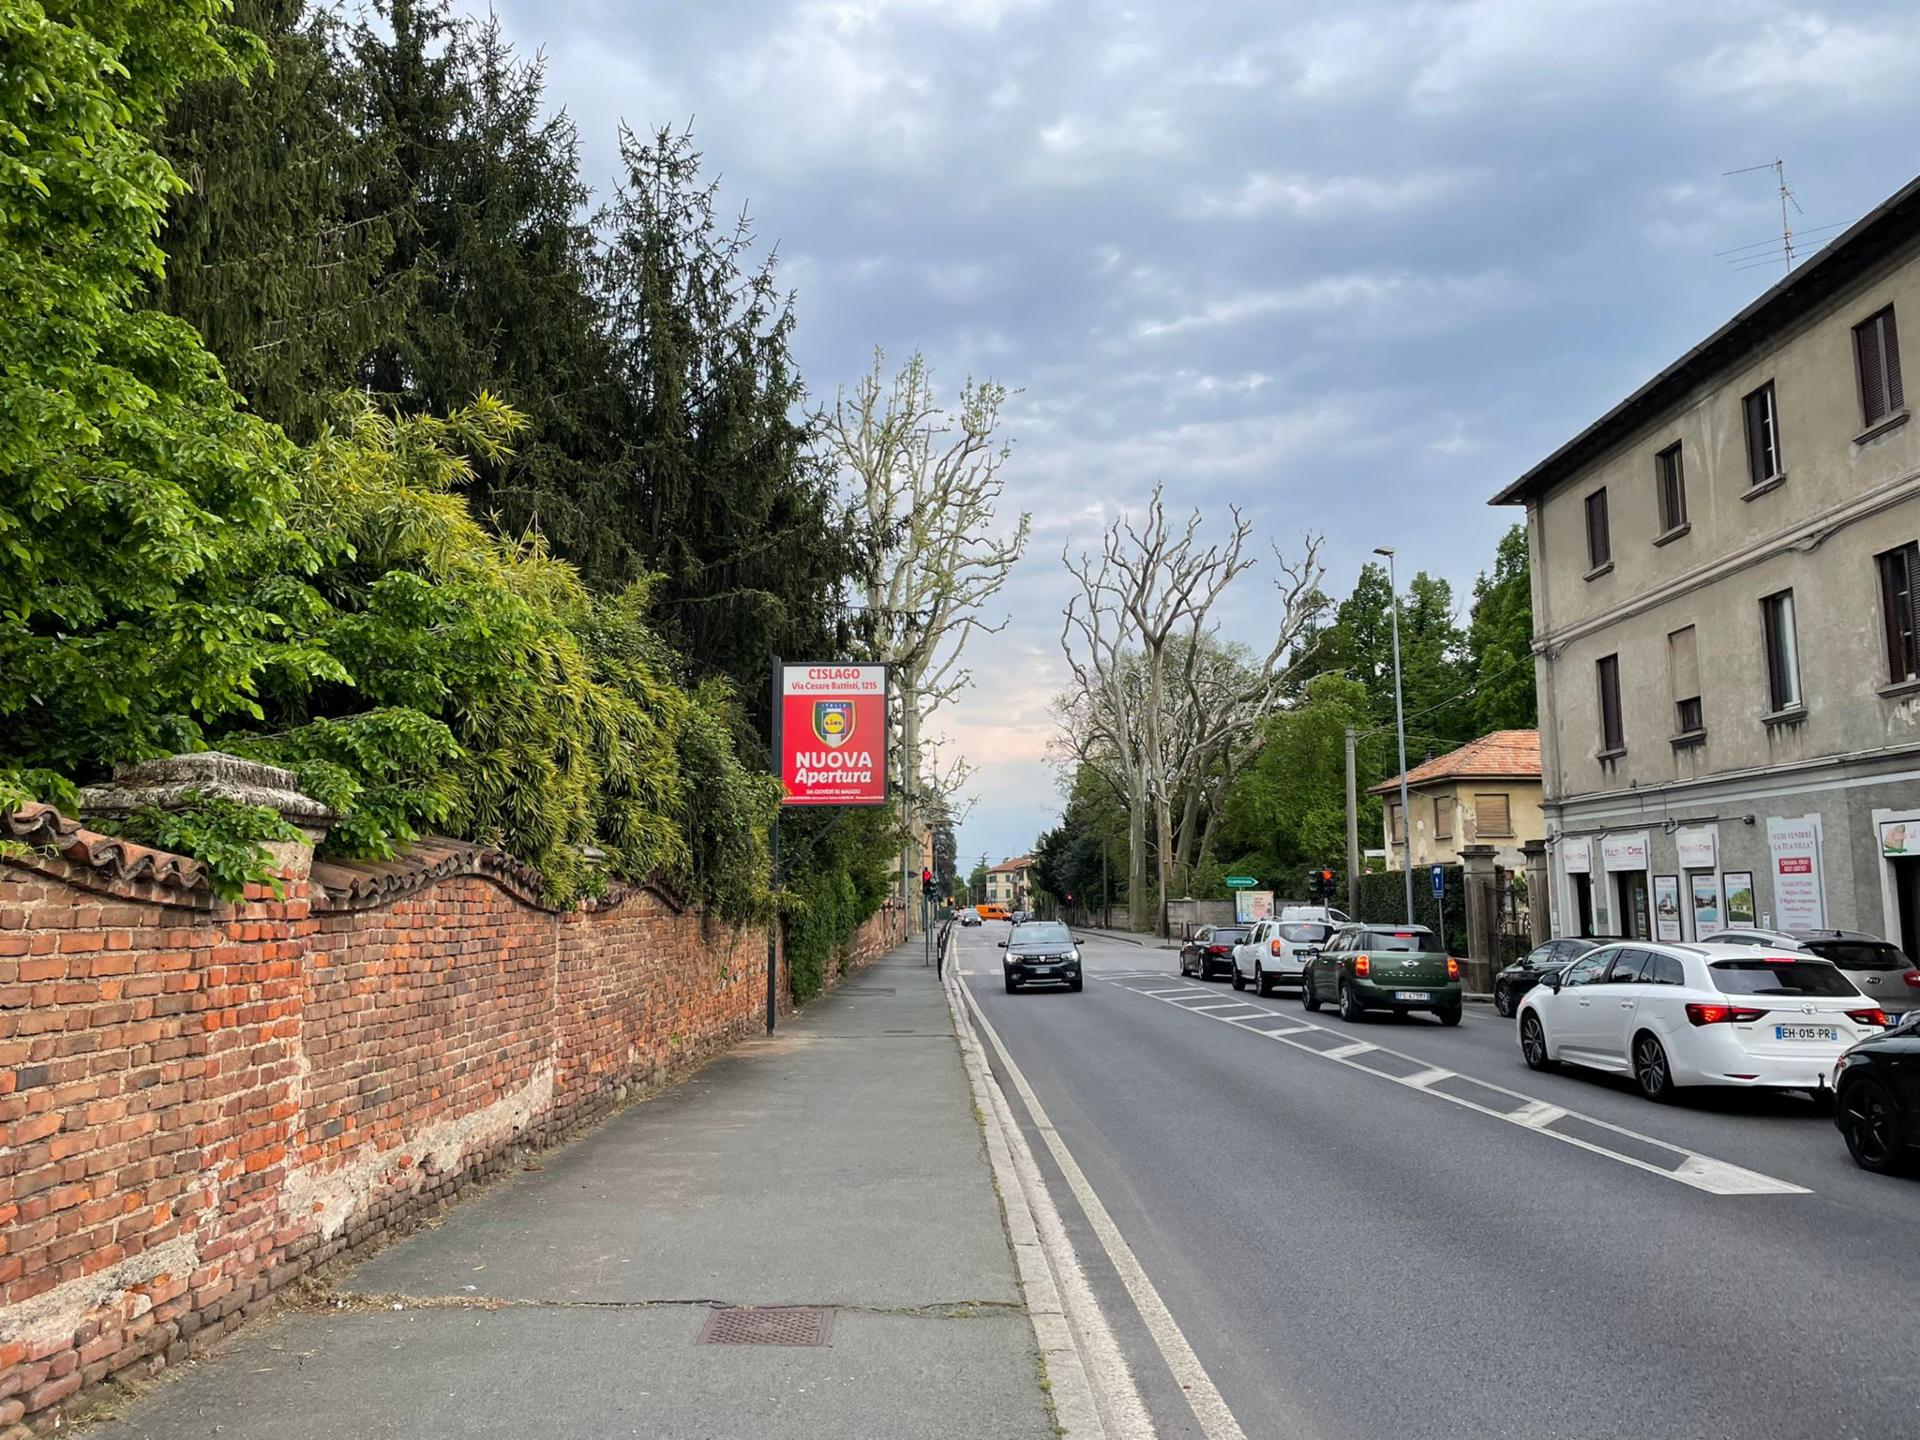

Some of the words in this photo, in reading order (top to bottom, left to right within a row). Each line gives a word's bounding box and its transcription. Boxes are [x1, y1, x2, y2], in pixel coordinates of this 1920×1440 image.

[808, 668, 860, 680] CISLAGO
[792, 682, 805, 690] Via
[805, 682, 831, 690] Cesare
[831, 682, 861, 691] Battisti,
[861, 682, 877, 690] 1215
[796, 751, 872, 767] NUOVA
[795, 768, 871, 786] Apertura
